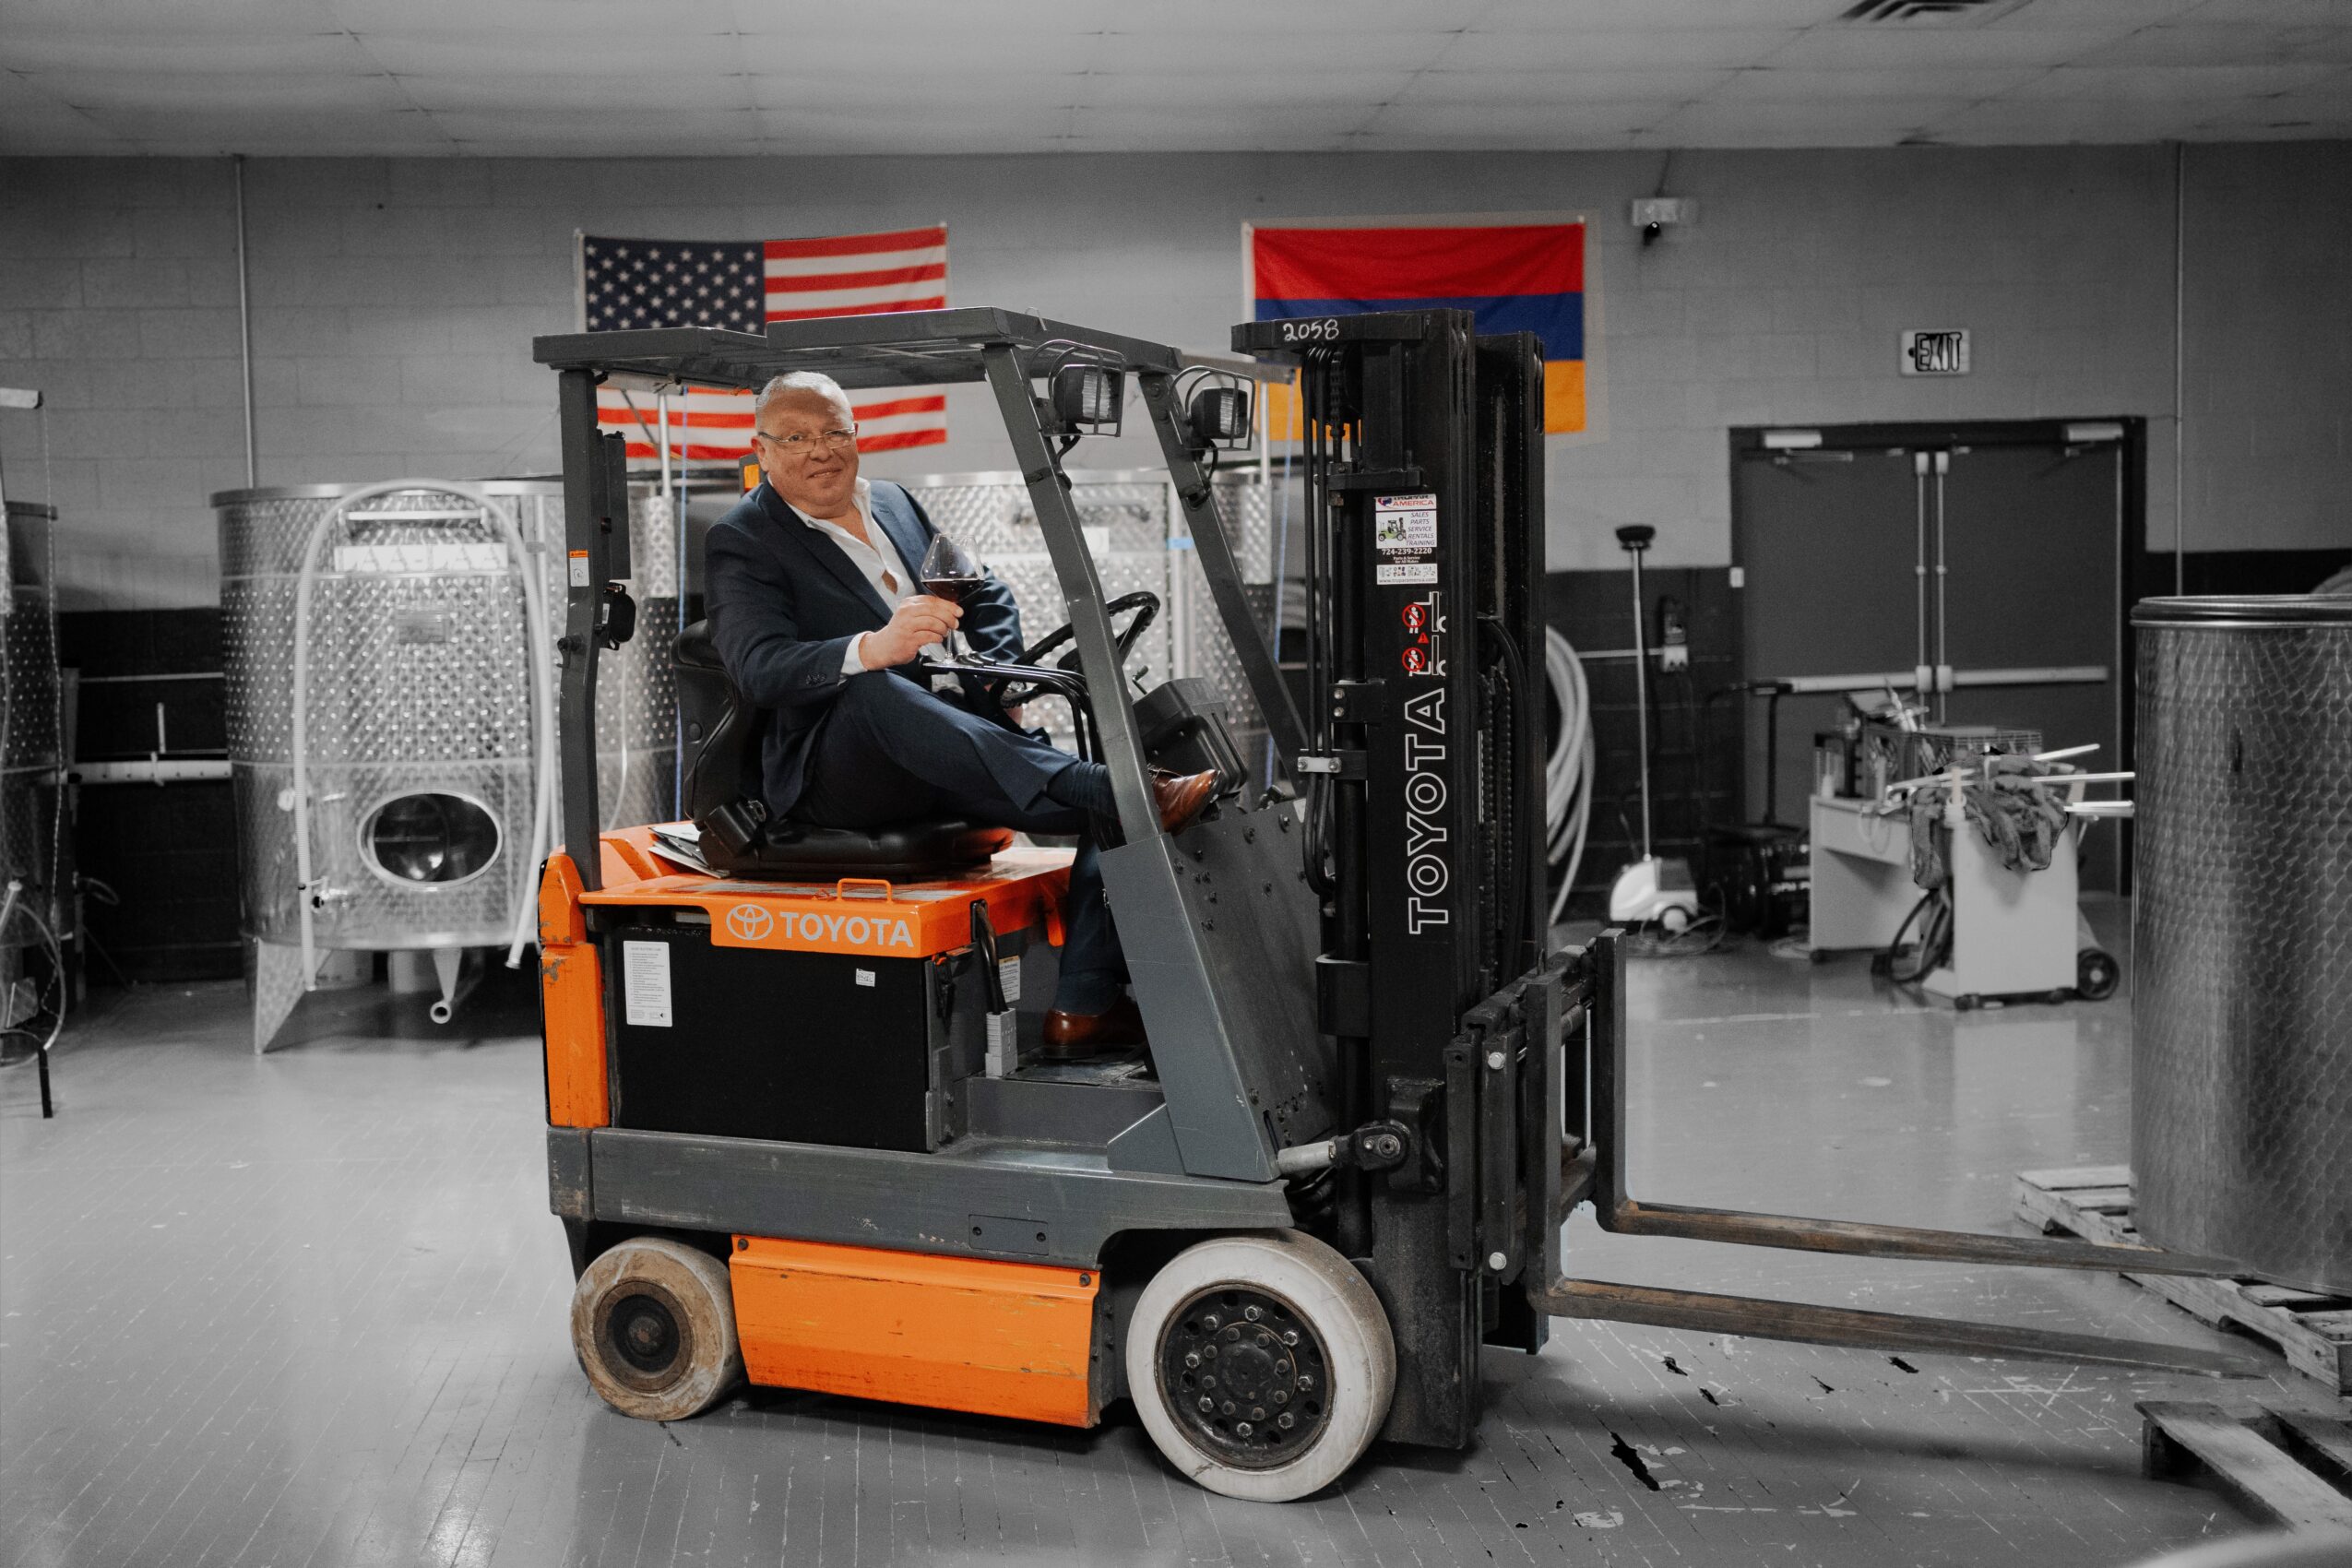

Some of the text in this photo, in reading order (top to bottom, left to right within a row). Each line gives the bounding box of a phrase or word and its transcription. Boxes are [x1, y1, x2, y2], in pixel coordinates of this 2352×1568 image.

[1283, 318, 1340, 341] 2058
[1915, 331, 1963, 373] EXIT
[1381, 547, 1432, 555] 724-239-2220
[1404, 687, 1449, 935] TOYOTA
[779, 911, 915, 948] TOYOTA
